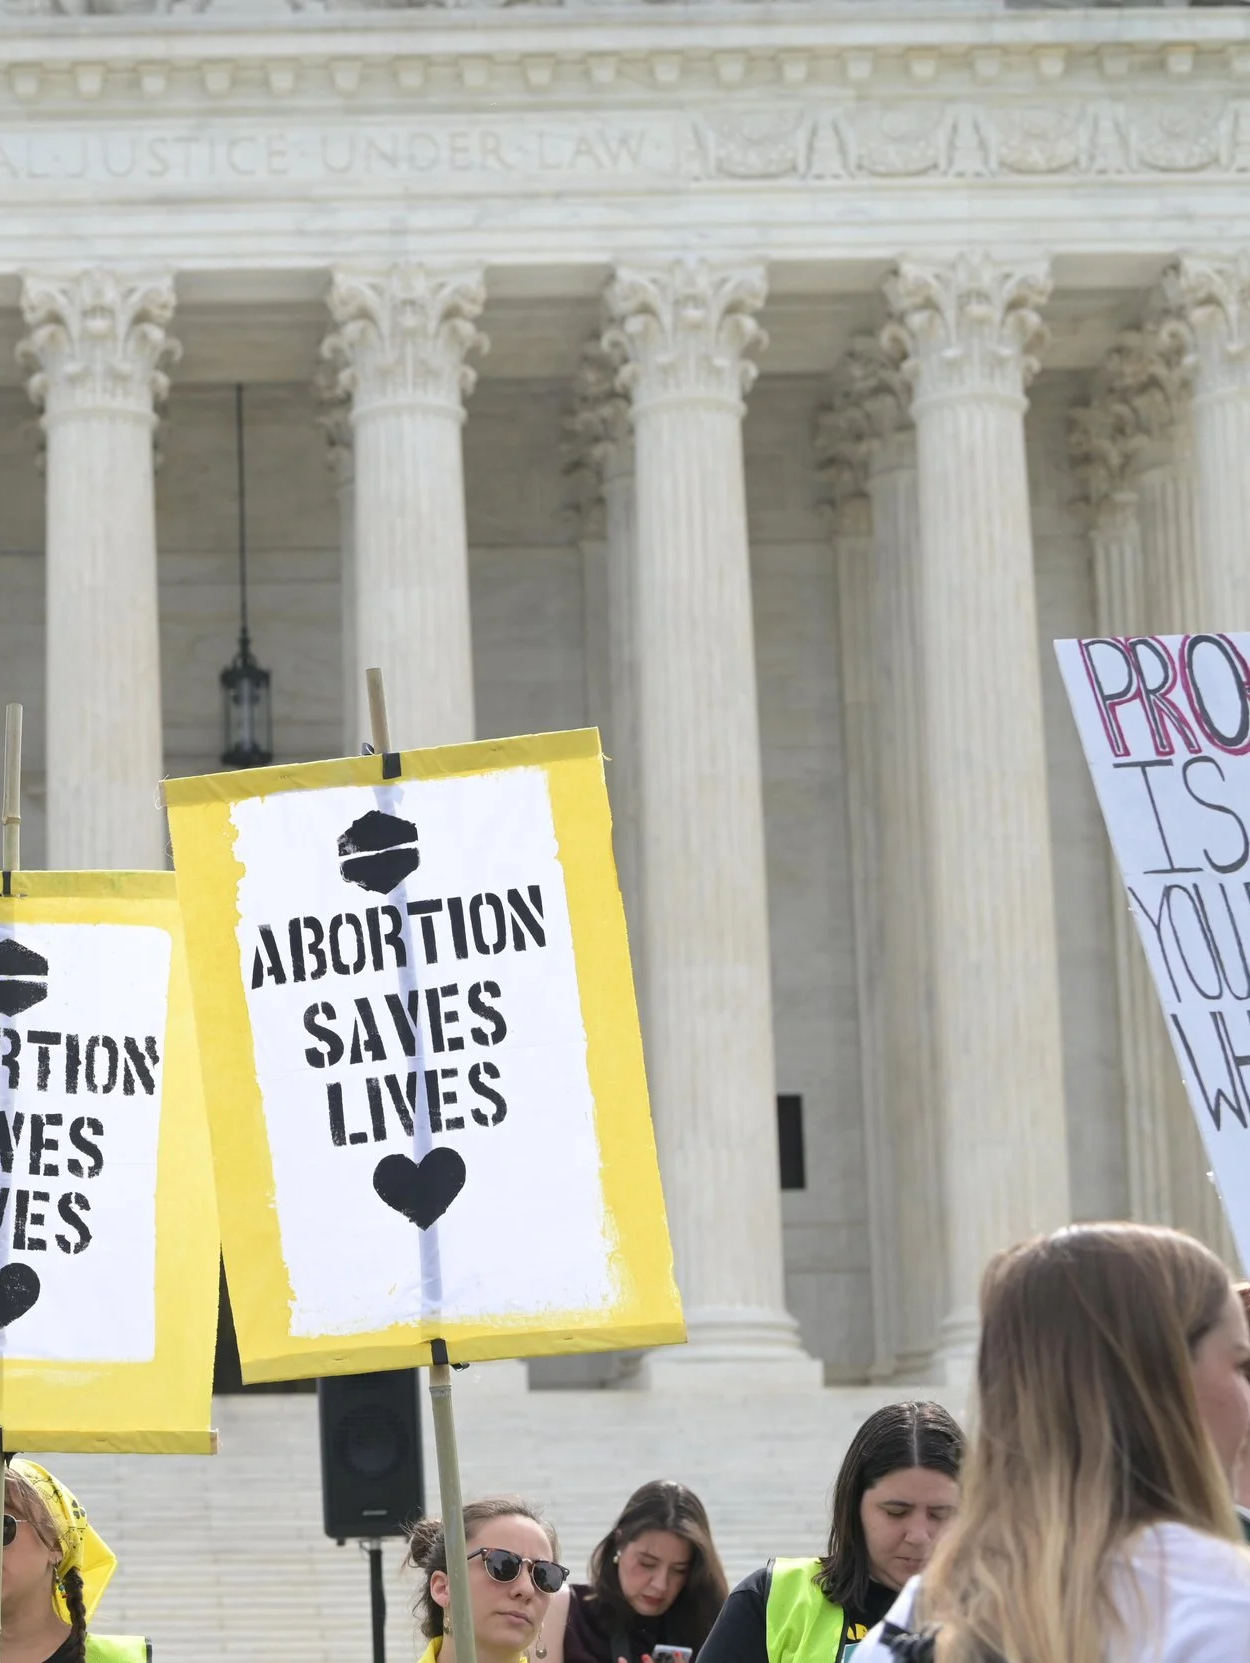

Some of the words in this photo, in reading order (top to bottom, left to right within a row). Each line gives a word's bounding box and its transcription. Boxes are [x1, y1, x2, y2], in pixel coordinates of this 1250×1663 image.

[63, 133, 288, 181] JUSTICE
[321, 130, 517, 174] UNDER
[535, 127, 646, 171] LAW
[1077, 633, 1250, 758] PRO
[1113, 754, 1250, 876] IS
[251, 884, 548, 990] ABORTION
[1128, 882, 1250, 1003] YOU
[303, 980, 508, 1068] SAVES
[1170, 1009, 1250, 1132] WH
[326, 1061, 508, 1147] LIVES
